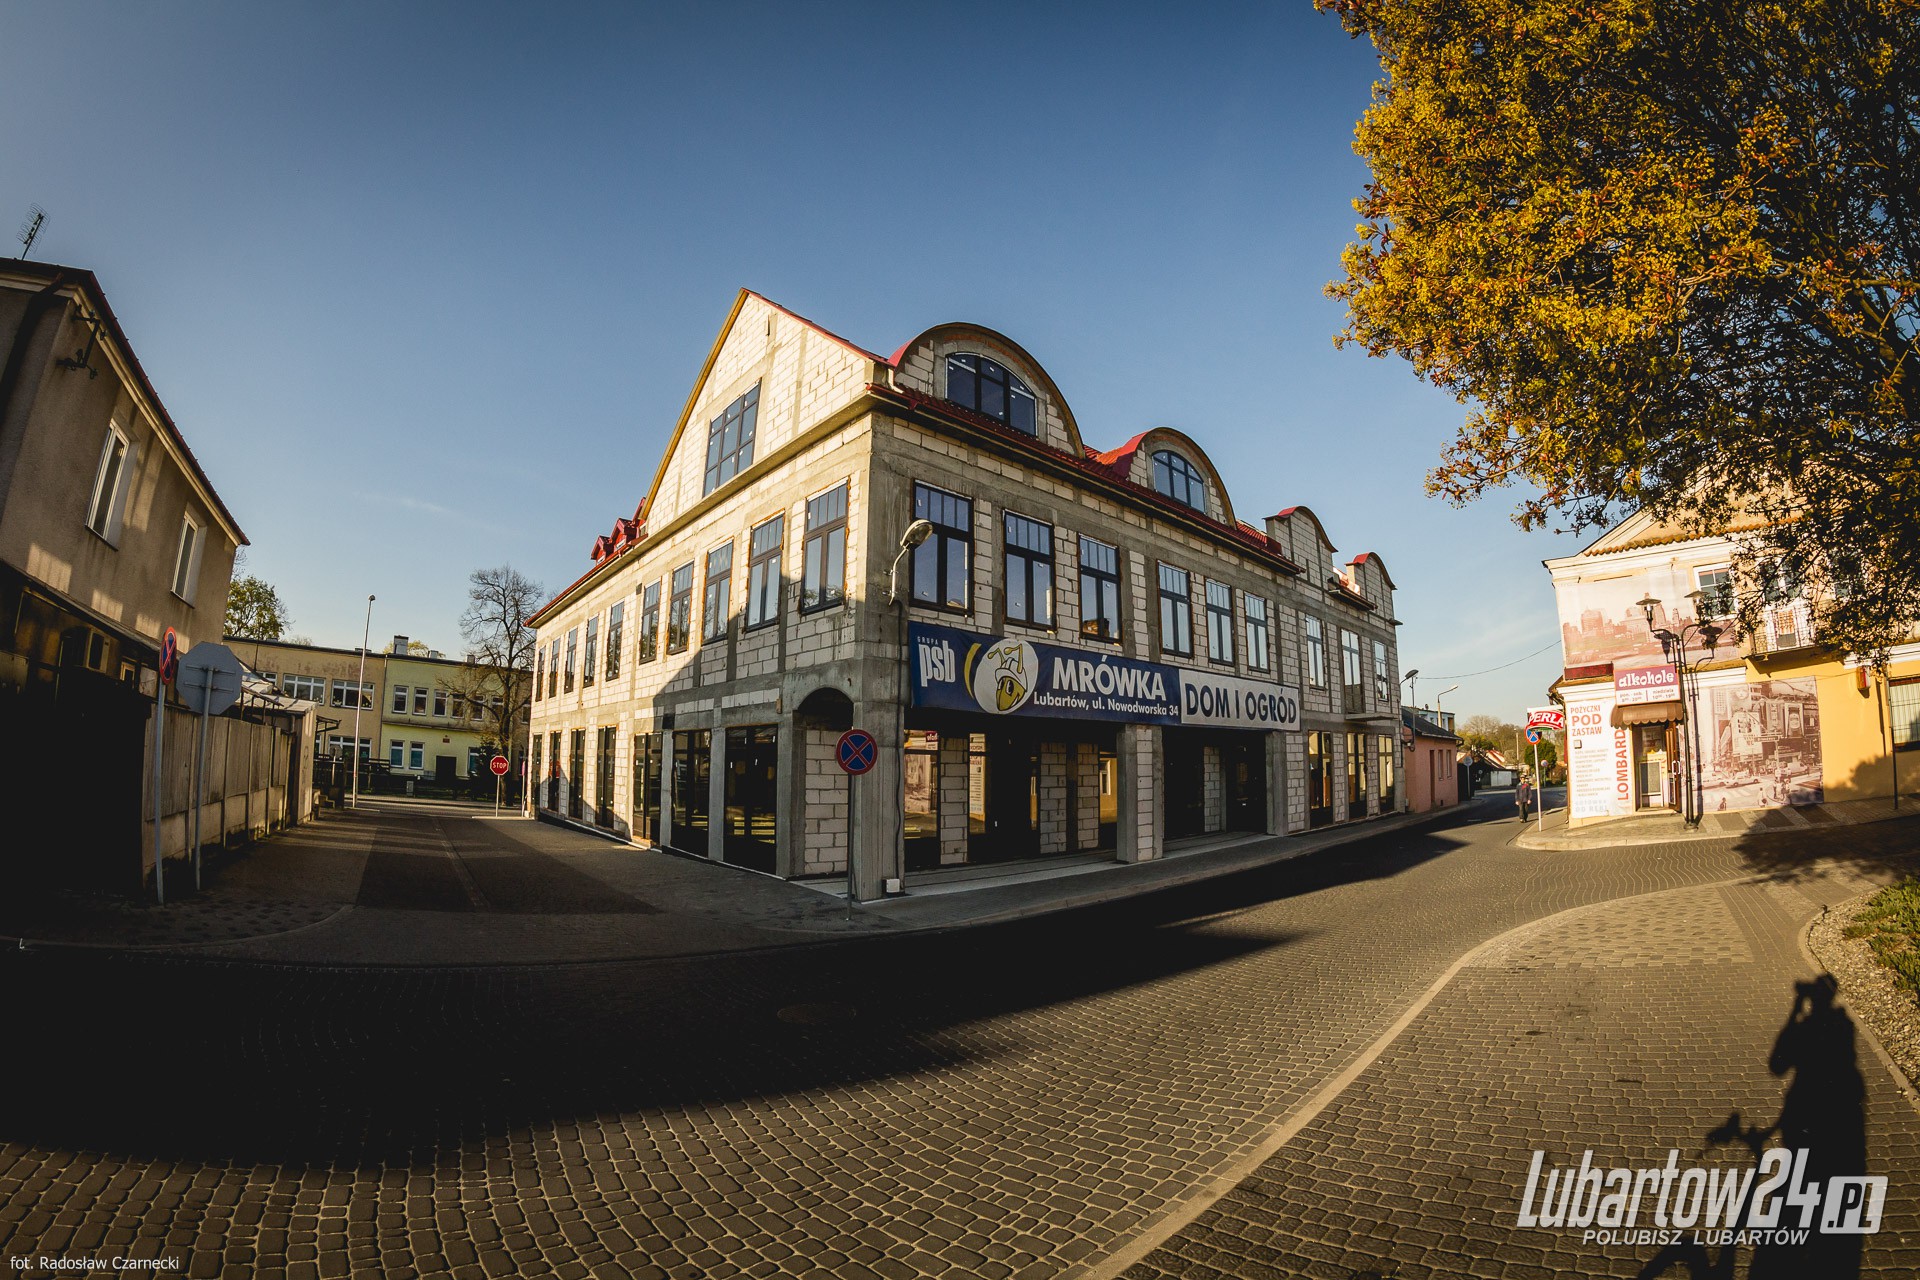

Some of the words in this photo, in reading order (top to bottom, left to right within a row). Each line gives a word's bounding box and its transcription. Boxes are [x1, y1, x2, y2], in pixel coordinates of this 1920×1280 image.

[917, 636, 939, 645] GRUPA
[918, 640, 956, 688] psb
[1052, 654, 1167, 701] MRÓWKA
[1618, 669, 1675, 688] alkohole
[1033, 692, 1090, 711] Lubartów,
[1092, 697, 1105, 710] ul.
[1108, 698, 1167, 716] Nowodworska
[1169, 705, 1179, 716] 34
[1184, 682, 1231, 718] DOM
[1234, 690, 1240, 720] I
[1244, 688, 1297, 724] OGRÓD
[1528, 710, 1564, 727] PERŁA
[1572, 713, 1602, 726] POD
[1572, 726, 1602, 736] ZASTAW
[1614, 728, 1629, 800] LOMBARD
